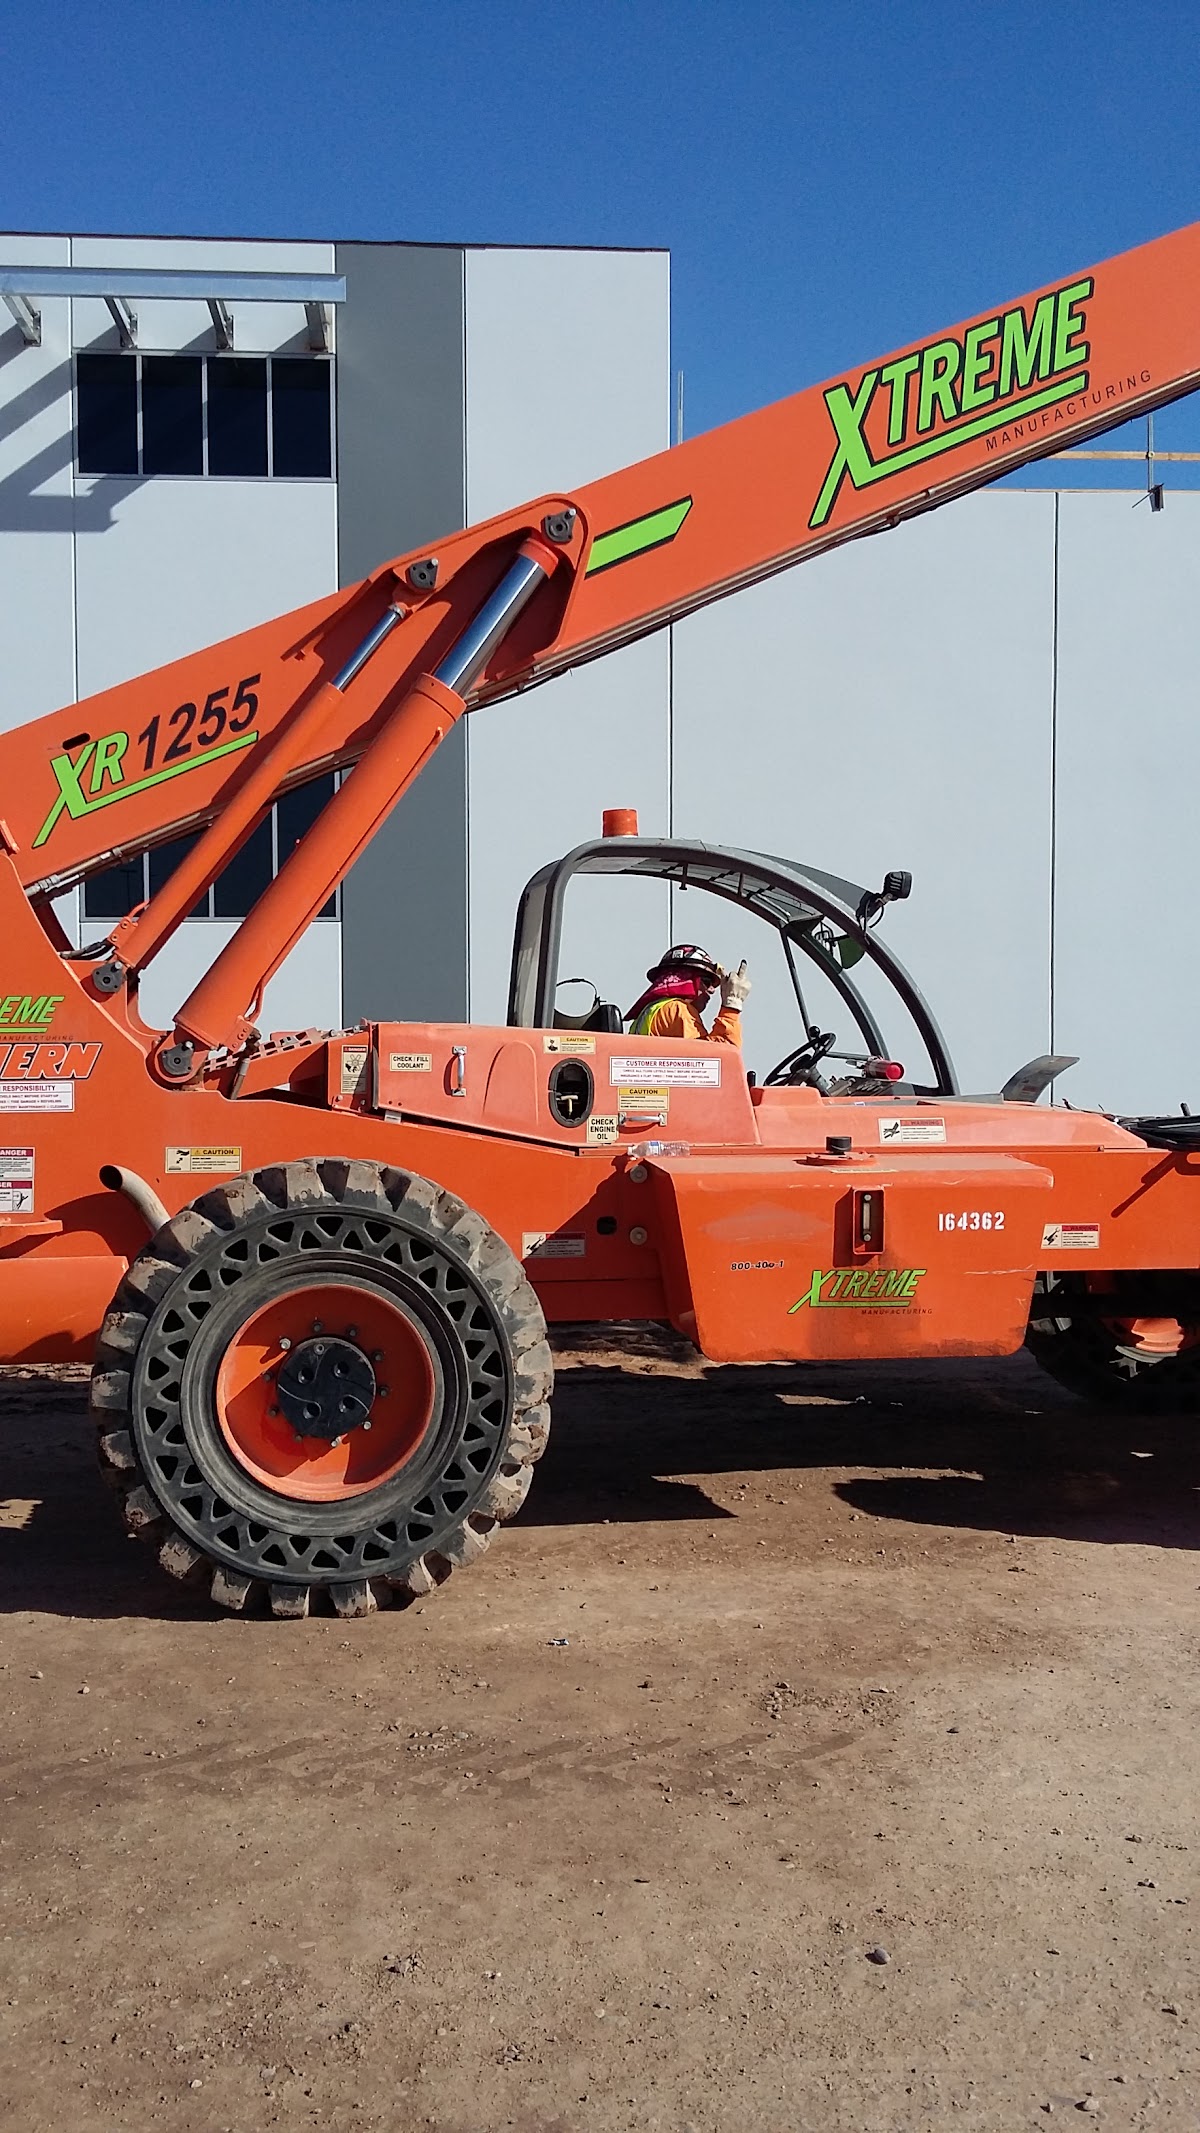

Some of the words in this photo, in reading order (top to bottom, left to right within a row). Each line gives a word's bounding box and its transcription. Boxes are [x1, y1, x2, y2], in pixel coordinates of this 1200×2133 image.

[807, 276, 1095, 529] XTREME
[985, 369, 1151, 451] MANUFACTURING
[32, 731, 129, 848] XR
[137, 673, 261, 772] 1255
[0, 995, 65, 1024] EME
[590, 1125, 616, 1133] ENGINE
[591, 1118, 614, 1126] CHECK
[938, 1211, 1006, 1232] 164362
[786, 1269, 927, 1314] XTREME
